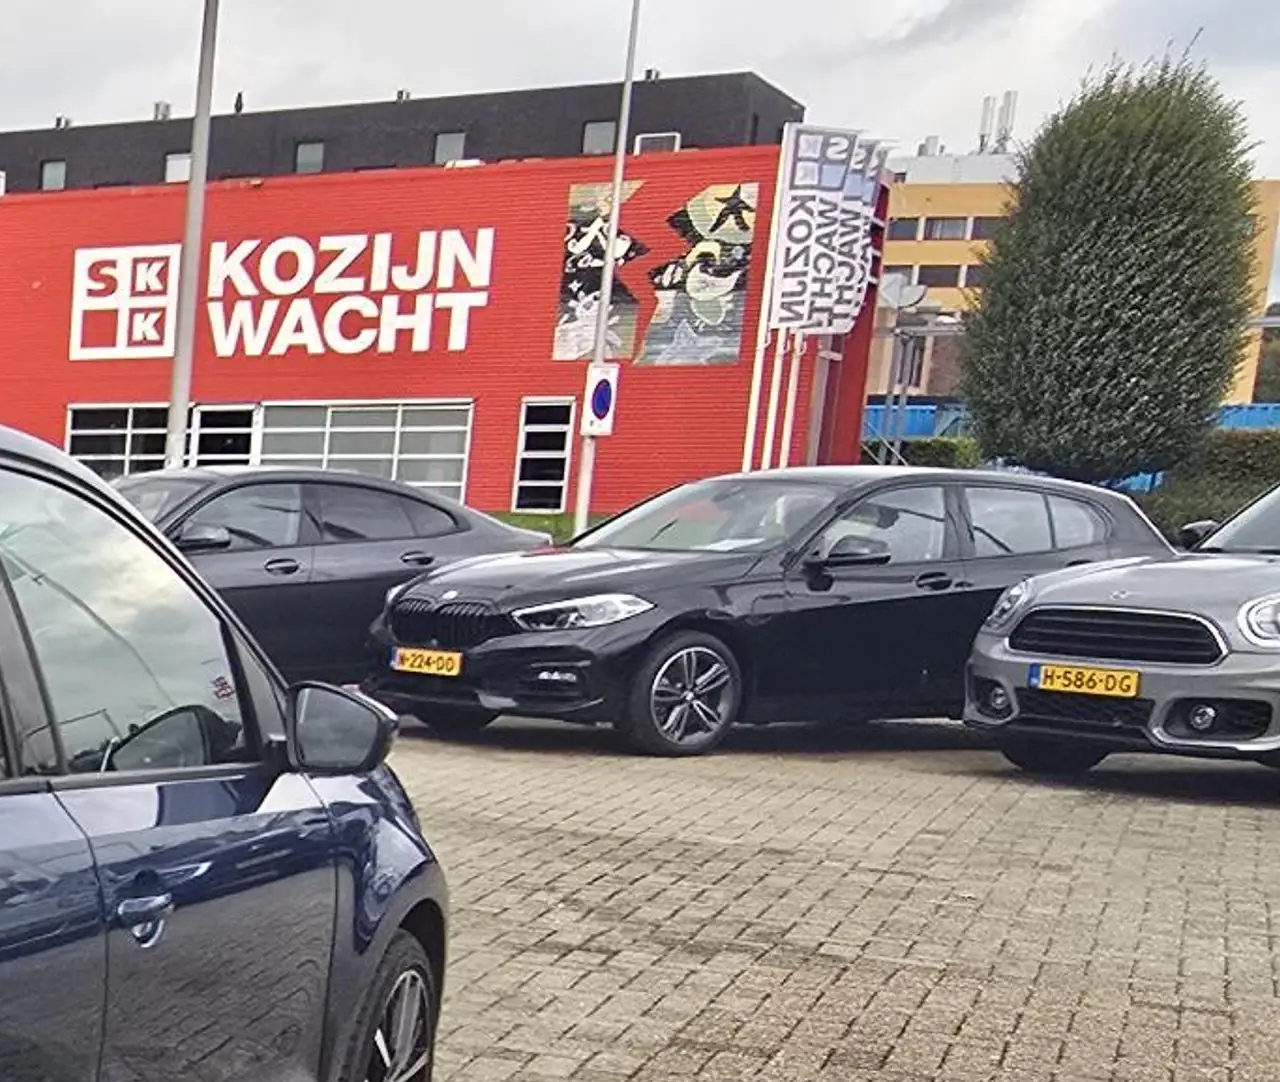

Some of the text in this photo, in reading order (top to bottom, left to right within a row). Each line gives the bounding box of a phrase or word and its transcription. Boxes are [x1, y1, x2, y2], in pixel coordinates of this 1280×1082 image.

[207, 227, 495, 298] KOZIJN
[207, 291, 489, 357] WACHT
[1042, 667, 1132, 694] H-586-DG
